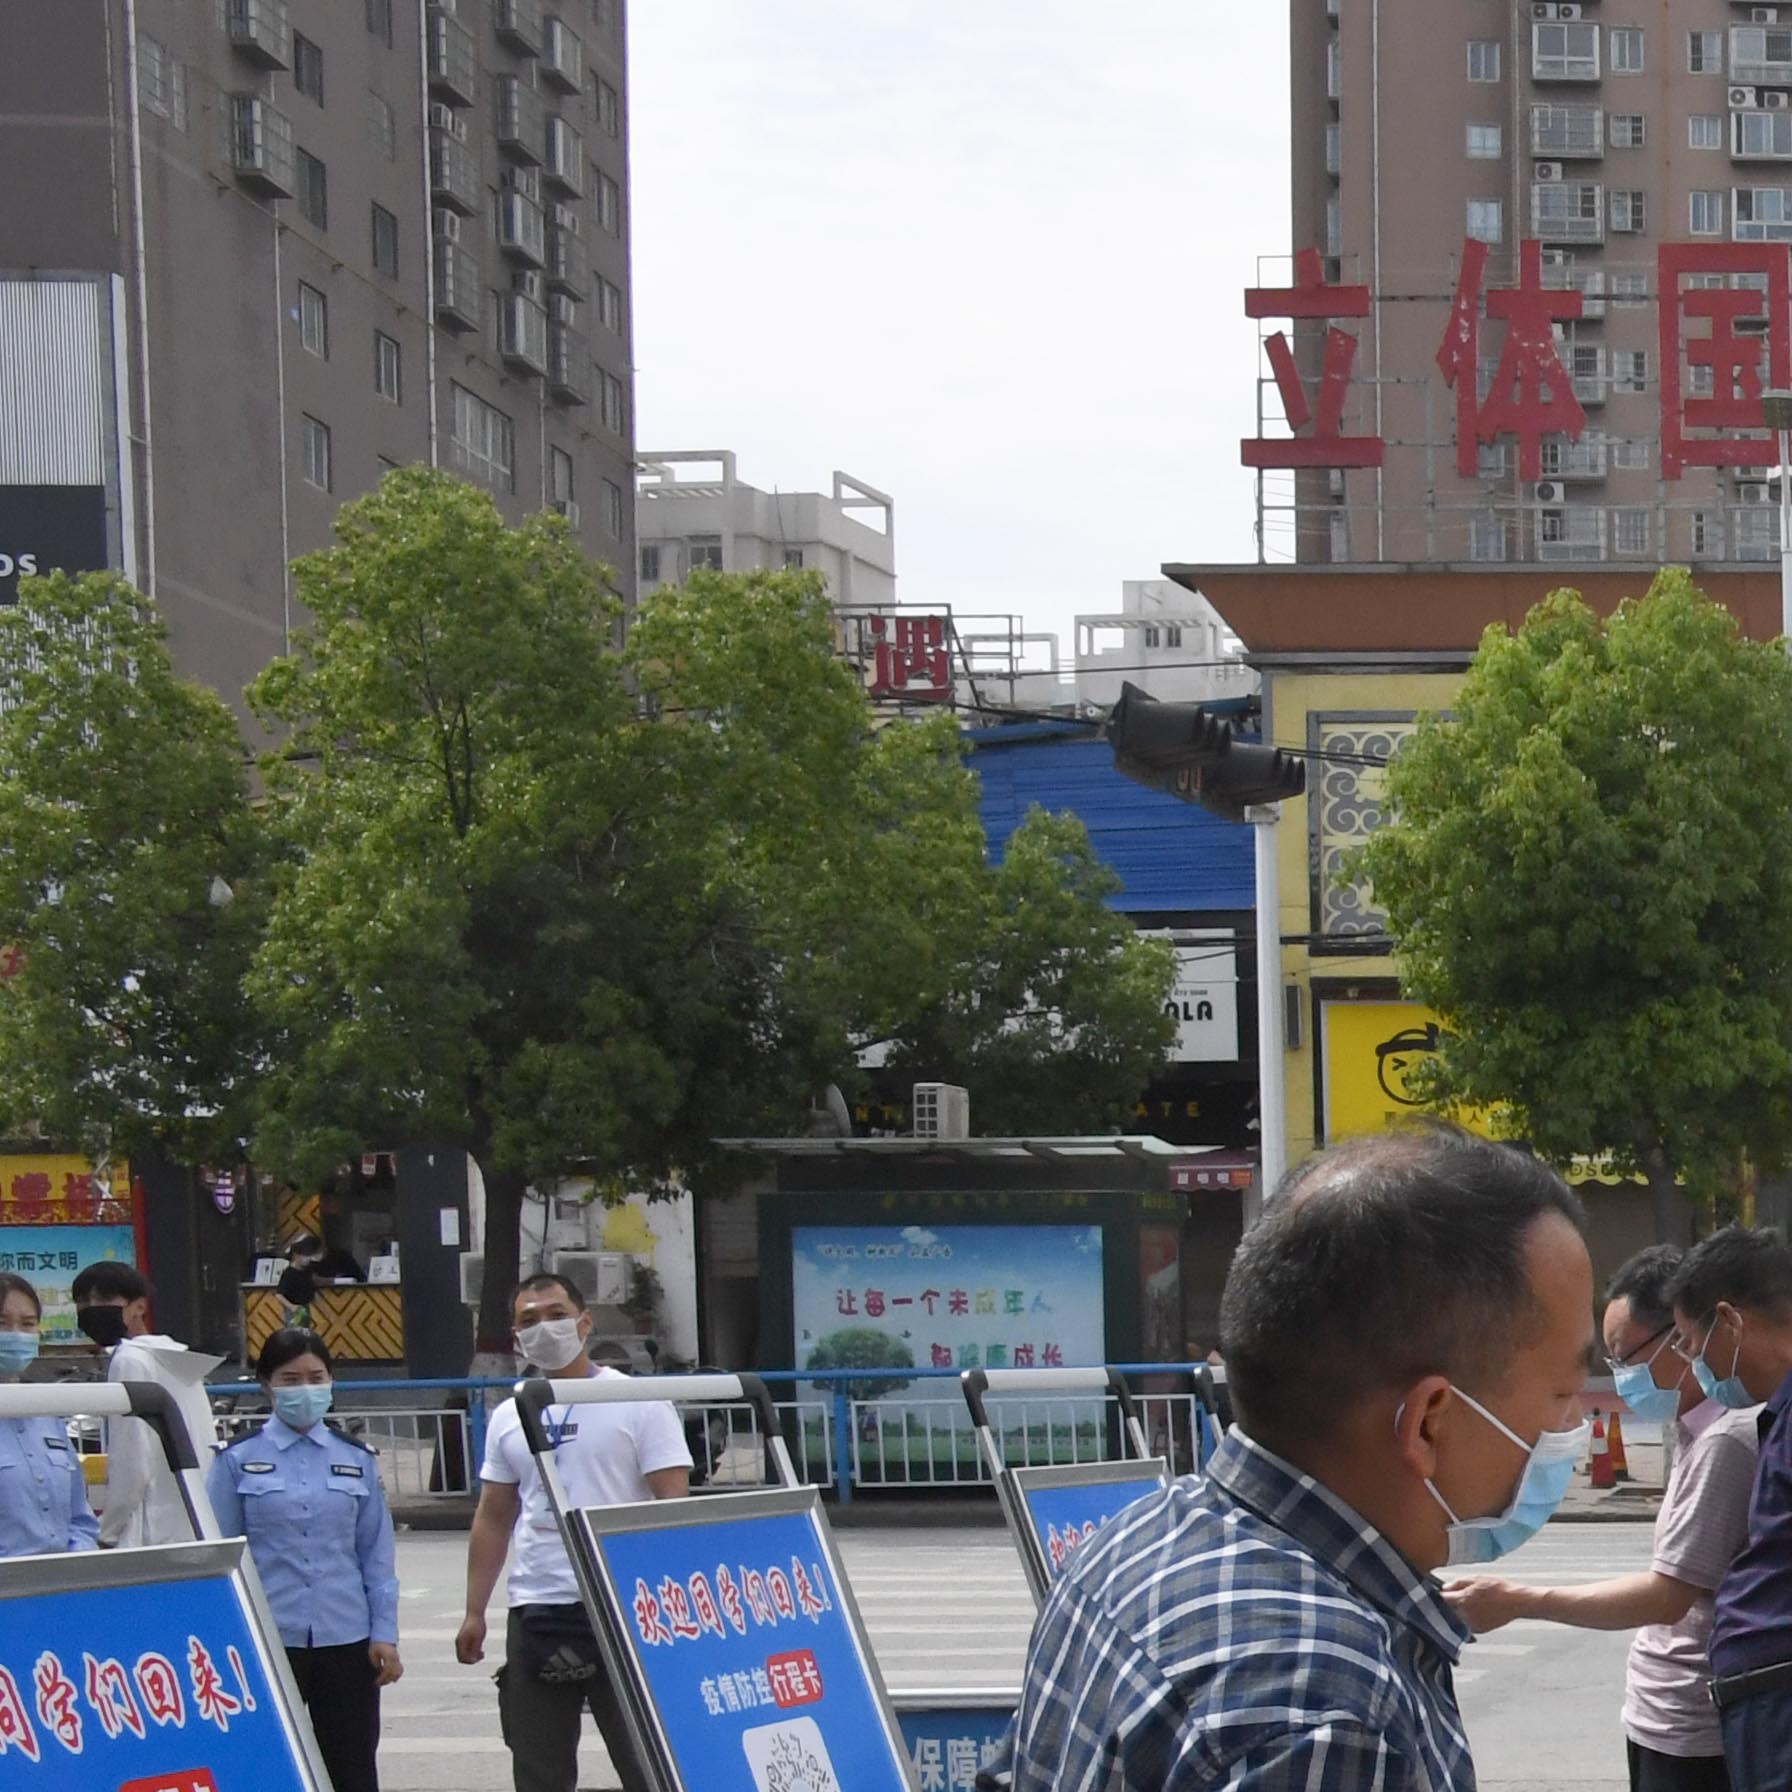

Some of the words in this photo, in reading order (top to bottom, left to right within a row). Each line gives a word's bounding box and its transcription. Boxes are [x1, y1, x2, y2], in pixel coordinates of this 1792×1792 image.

[632, 1555, 833, 1647] 欢迎同学们回来!
